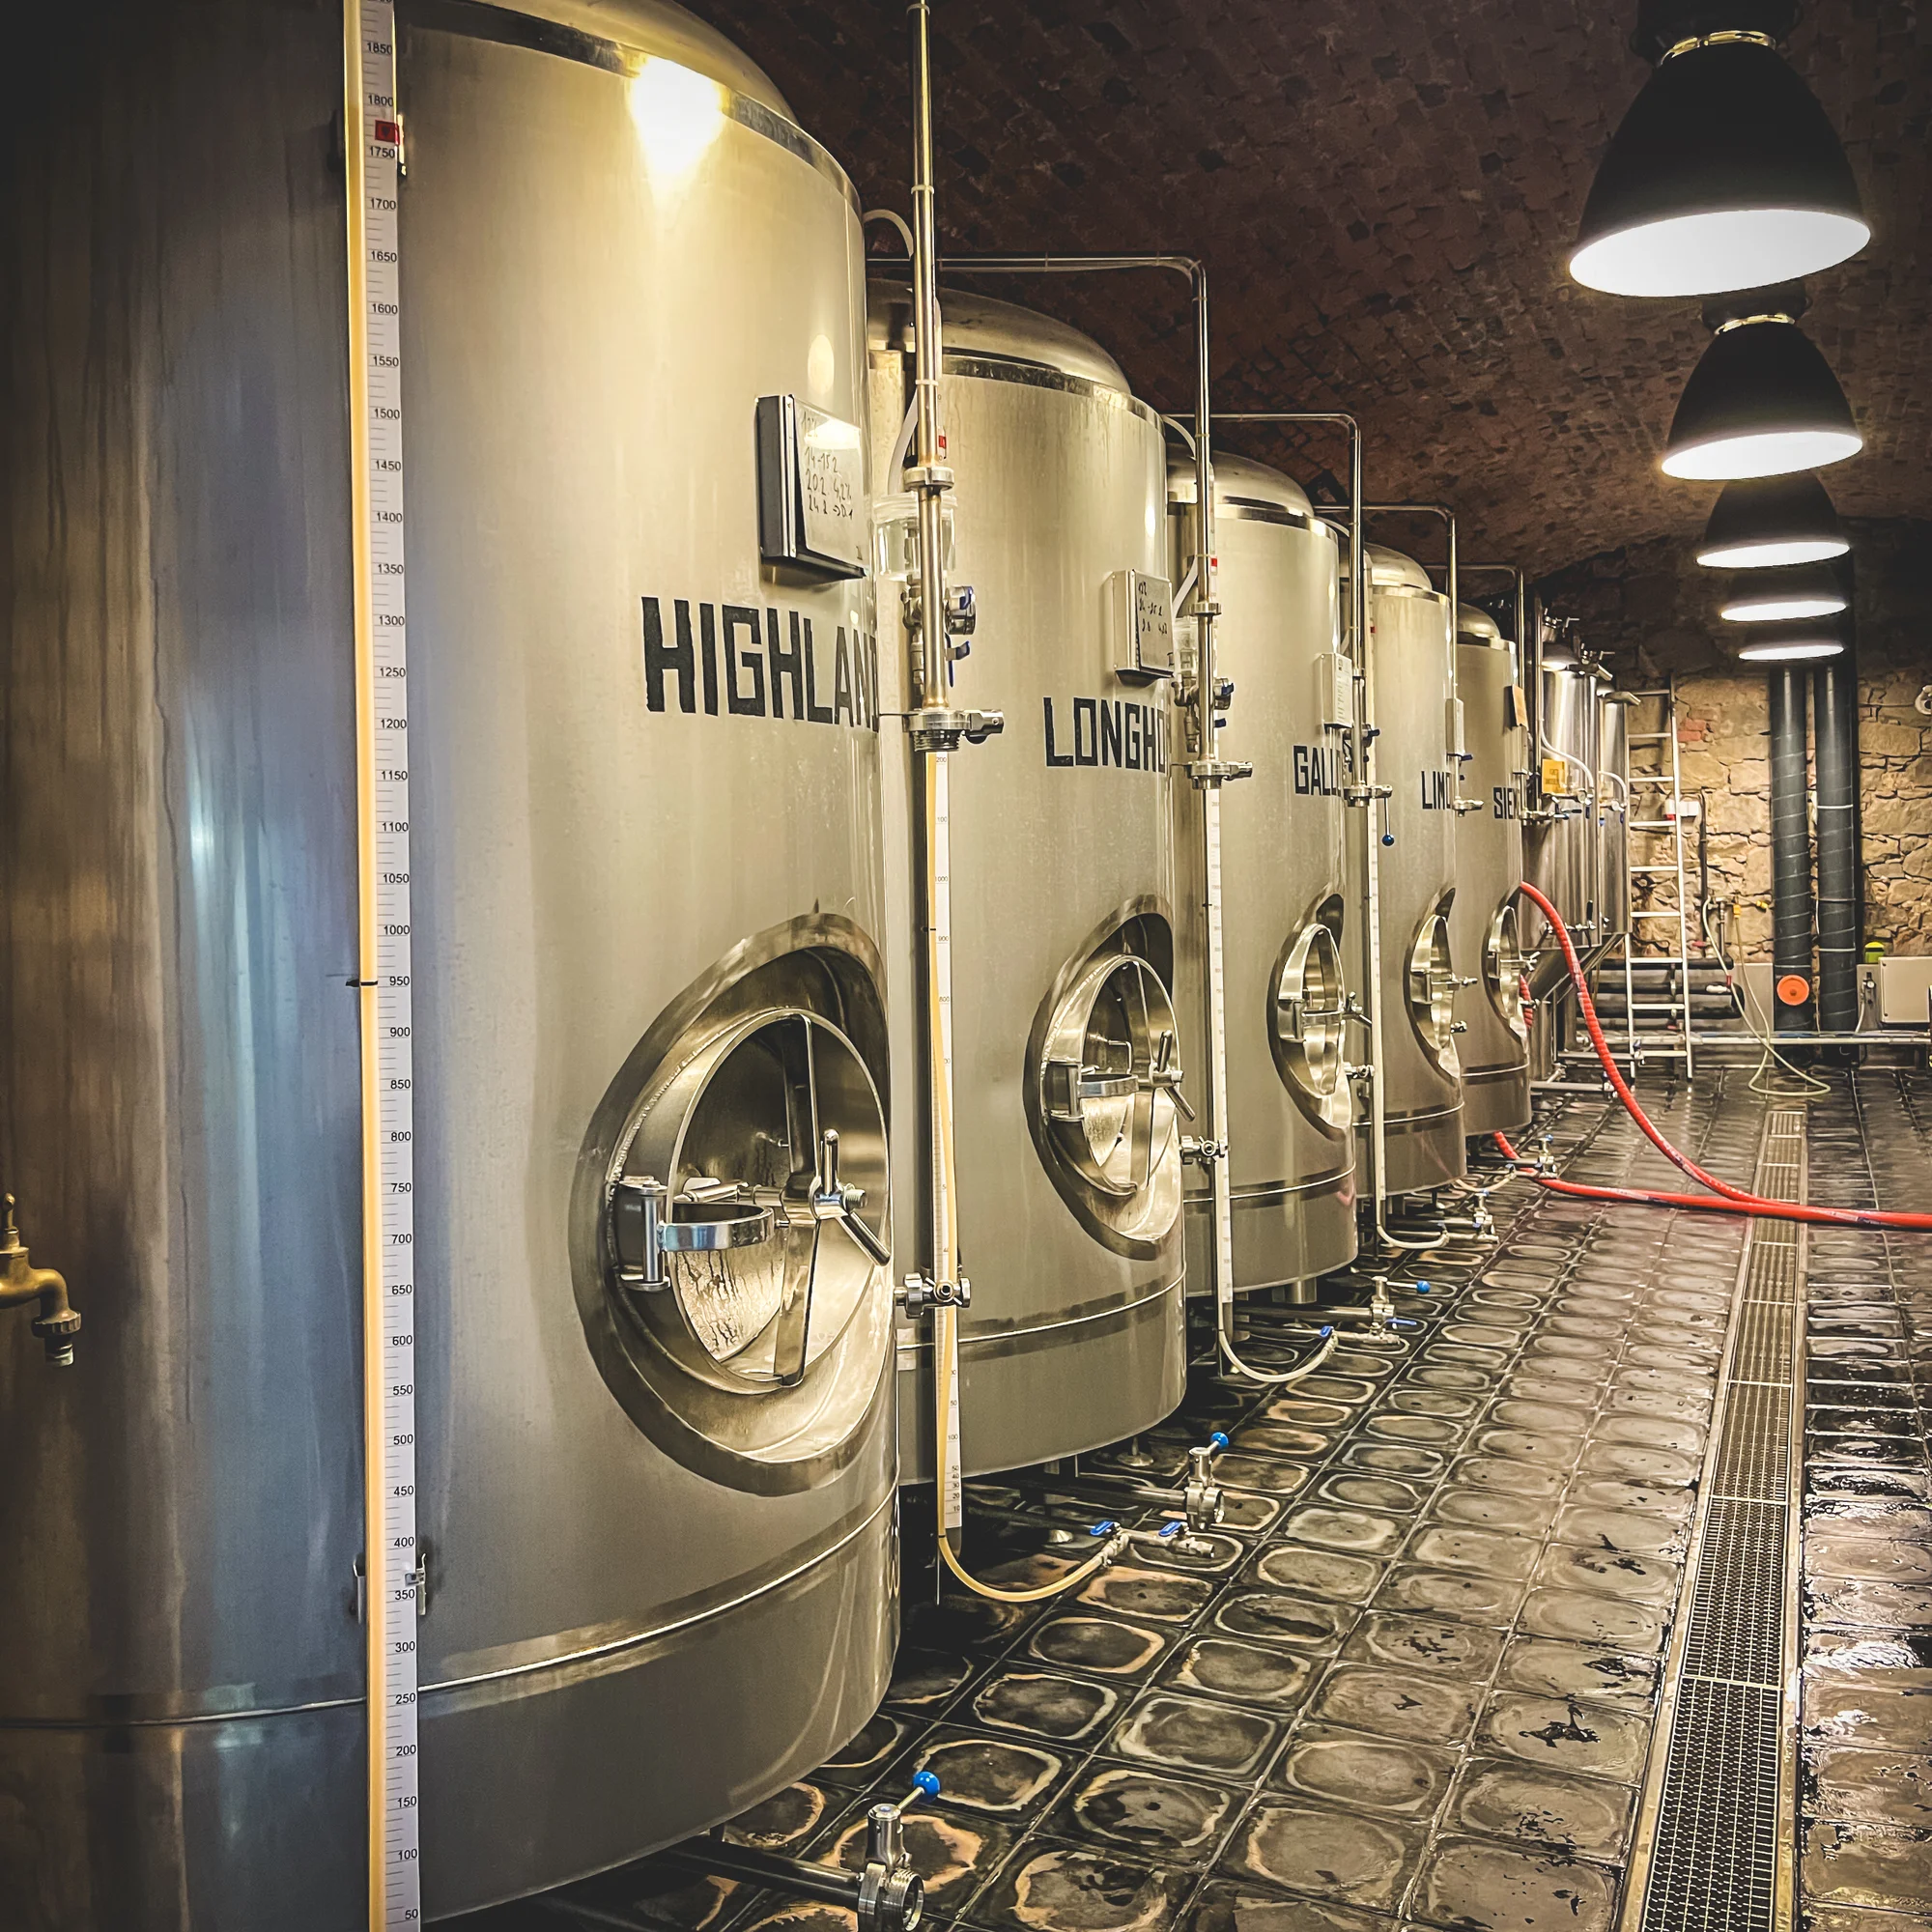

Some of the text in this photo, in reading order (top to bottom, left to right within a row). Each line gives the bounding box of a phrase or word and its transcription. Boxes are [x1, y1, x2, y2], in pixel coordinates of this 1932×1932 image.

[367, 43, 392, 55] 1850
[368, 95, 393, 107] 1800
[369, 147, 395, 158] 1750
[370, 199, 396, 211] 1700
[371, 251, 397, 263] 1650
[372, 303, 398, 316] 1600
[373, 355, 399, 368] 1550
[374, 408, 400, 420] 1500
[375, 460, 401, 471] 1450
[377, 512, 403, 524] 1400
[378, 563, 404, 575] 1350
[379, 615, 405, 627] 1300
[380, 667, 406, 678] 1250
[381, 719, 407, 730] 1200
[382, 770, 408, 781] 1150
[383, 821, 409, 833] 1100
[383, 872, 410, 884] 1050
[384, 924, 410, 936] 1000
[390, 976, 410, 987] 950
[390, 1026, 411, 1037] 900
[390, 1078, 411, 1090] 850
[391, 1130, 412, 1142] 800
[391, 1182, 412, 1194] 750
[392, 1233, 412, 1244] 700
[392, 1284, 412, 1295] 650
[393, 1334, 413, 1346] 600
[393, 1384, 413, 1396] 550
[394, 1434, 413, 1445] 500
[394, 1485, 414, 1496] 450
[394, 1536, 414, 1548] 400
[395, 1589, 414, 1601] 350
[395, 1640, 415, 1652] 300
[396, 1692, 416, 1704] 250
[396, 1744, 416, 1756] 200
[398, 1796, 417, 1807] 150
[398, 1848, 417, 1860] 100
[406, 1908, 418, 1919] 50
